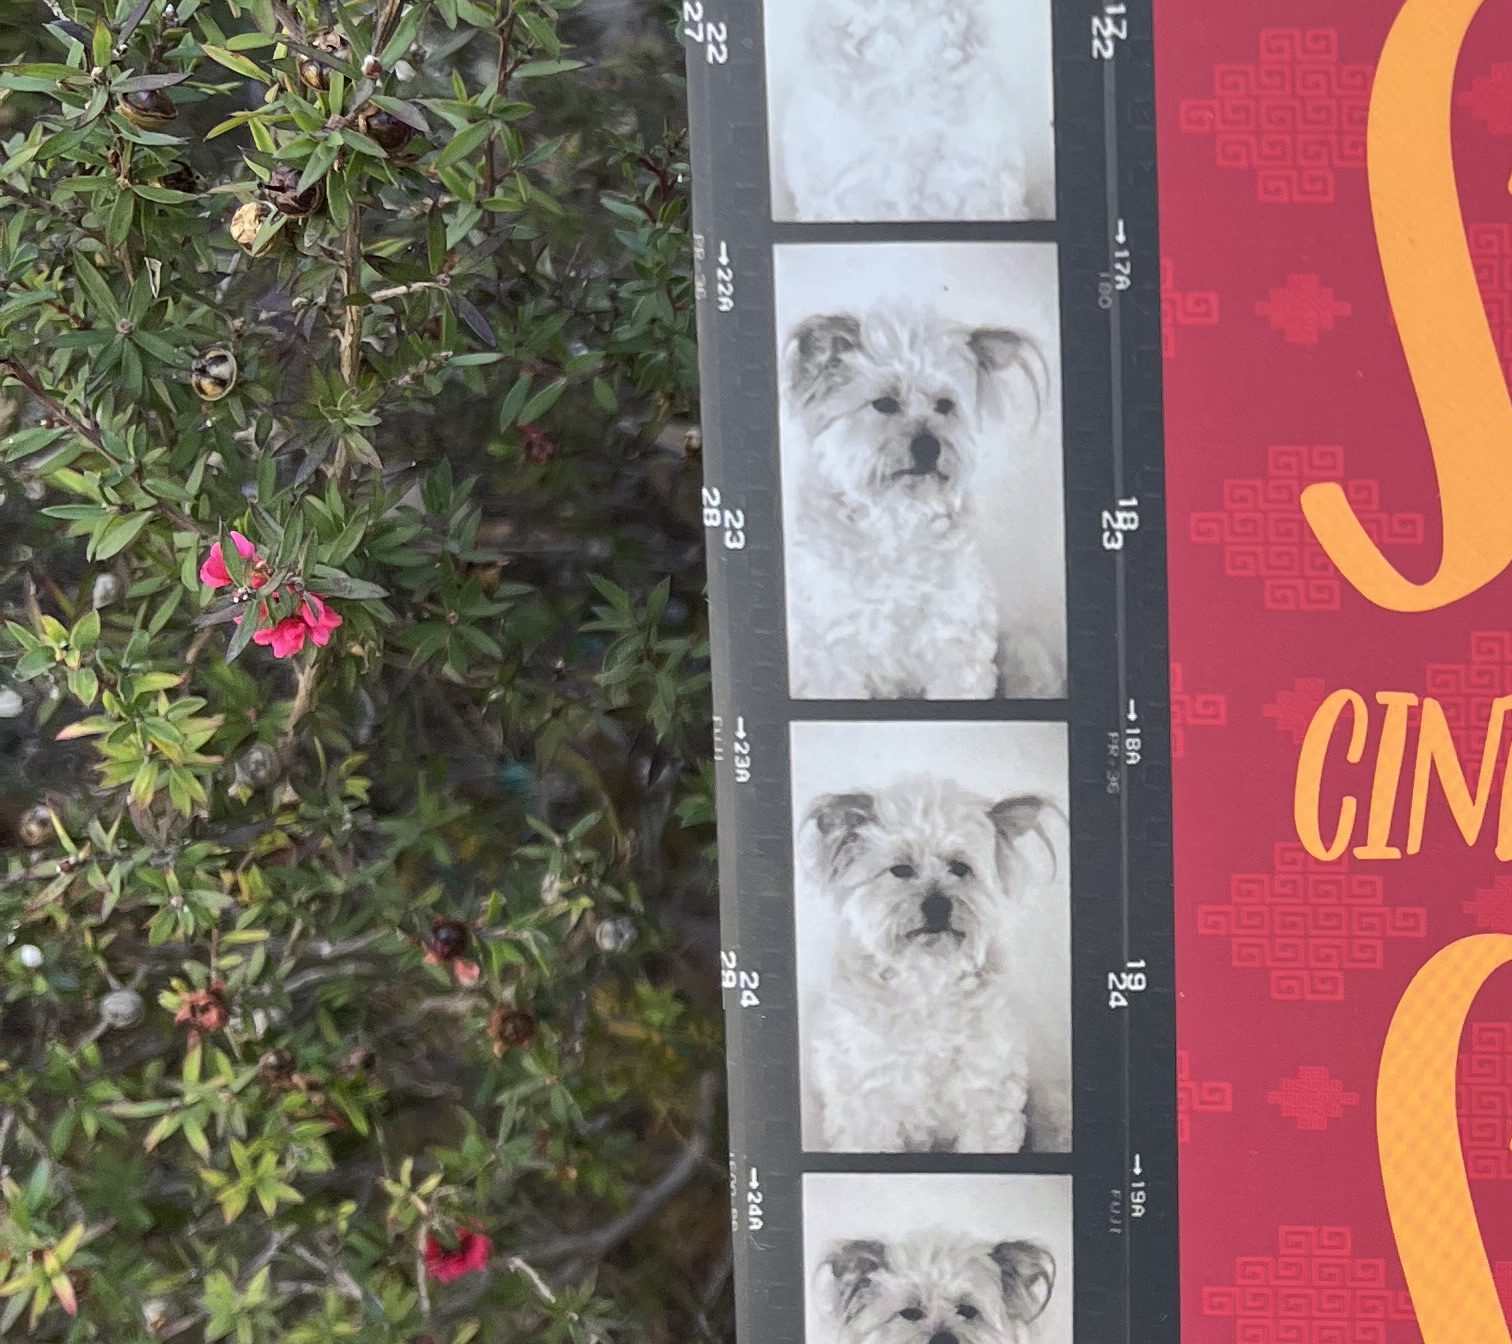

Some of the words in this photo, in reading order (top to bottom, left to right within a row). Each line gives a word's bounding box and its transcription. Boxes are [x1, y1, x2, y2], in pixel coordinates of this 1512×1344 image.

[683, 0, 704, 43] 27
[706, 22, 729, 65] 22
[716, 267, 734, 312] 22A
[1114, 249, 1131, 290] 17A
[701, 485, 721, 528] 28
[1117, 496, 1140, 531] 18
[723, 508, 746, 550] 23
[1101, 509, 1124, 550] 23
[733, 741, 752, 783] 23A
[1124, 728, 1142, 765] 18A
[740, 970, 761, 1009] 24
[1108, 971, 1129, 1010] 24
[1126, 959, 1147, 992] 19
[746, 1190, 764, 1231] 24A
[1129, 1181, 1147, 1218] 19A
